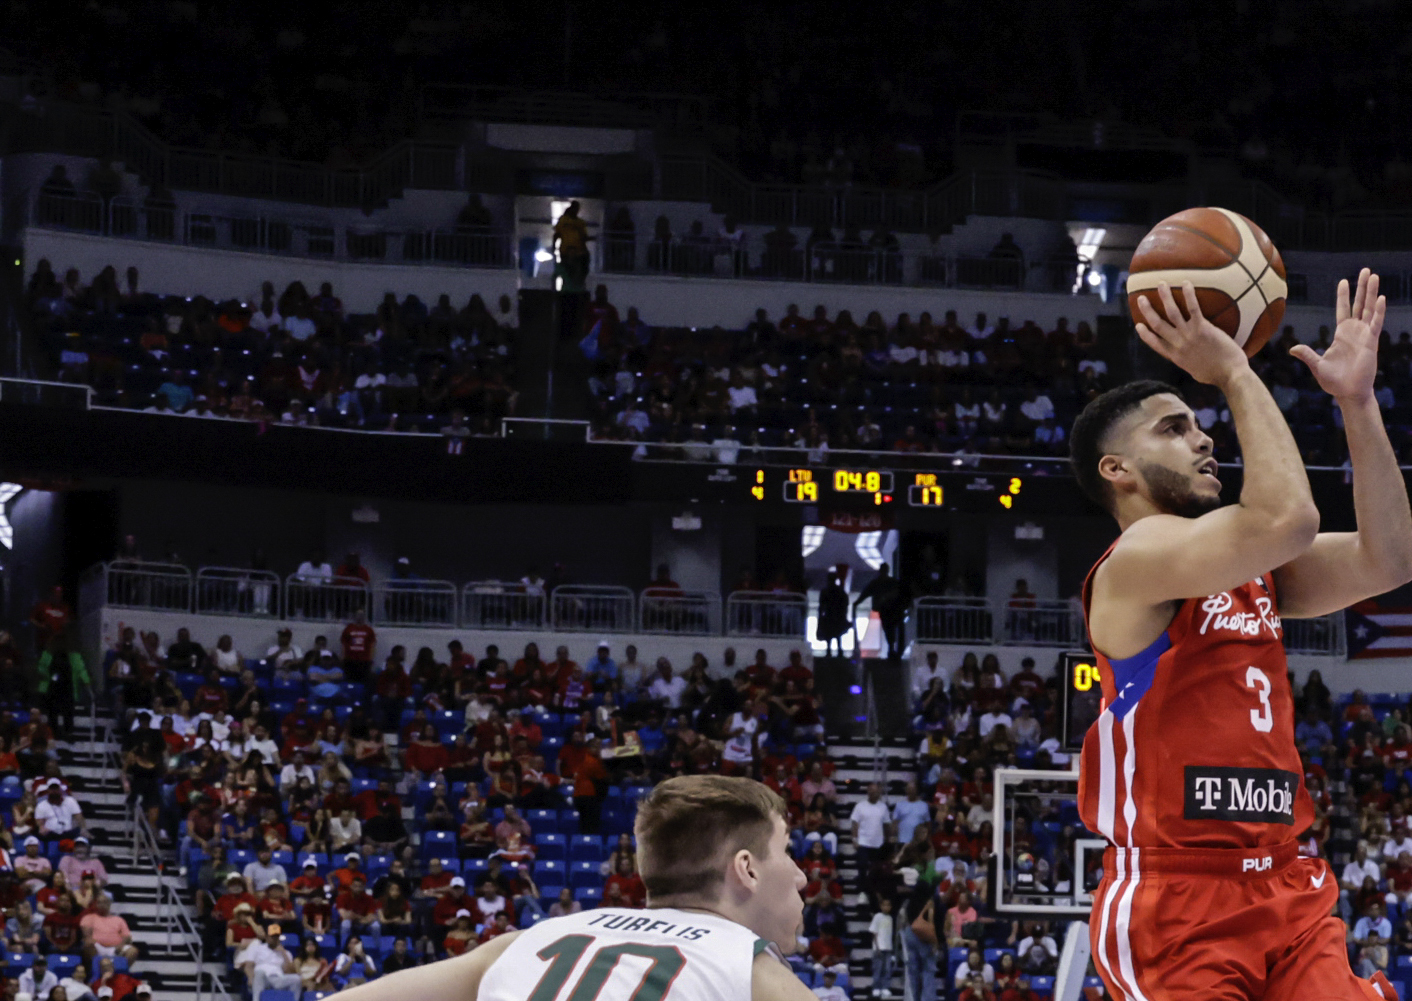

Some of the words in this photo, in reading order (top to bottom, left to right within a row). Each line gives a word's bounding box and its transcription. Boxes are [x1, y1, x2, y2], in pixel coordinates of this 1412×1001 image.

[788, 469, 812, 482] LTU
[834, 470, 881, 492] 04.8
[915, 473, 937, 486] PUR
[796, 482, 818, 501] 19
[921, 486, 943, 506] 17
[1200, 591, 1261, 636] Puerto
[1246, 665, 1274, 733] 3
[1227, 777, 1293, 816] Mobile
[1242, 856, 1273, 872] PUR
